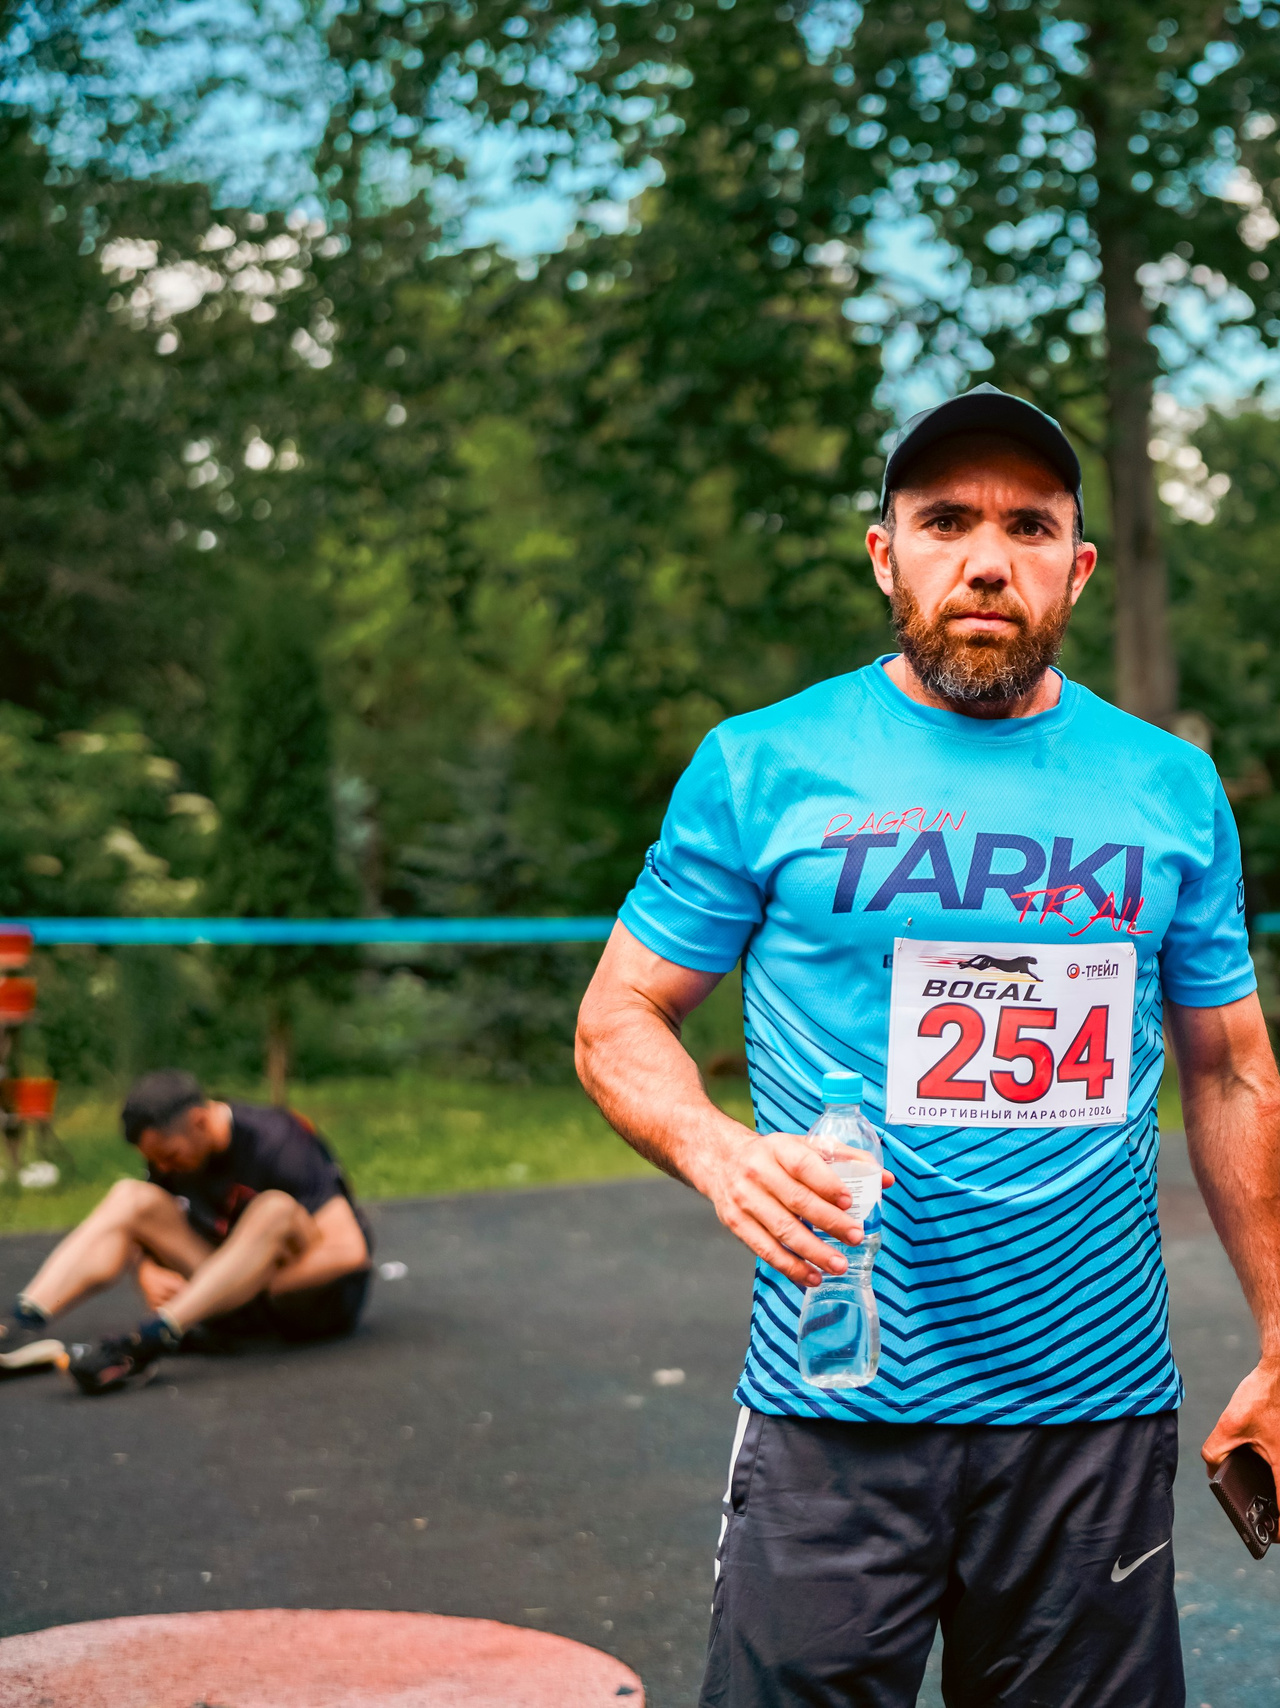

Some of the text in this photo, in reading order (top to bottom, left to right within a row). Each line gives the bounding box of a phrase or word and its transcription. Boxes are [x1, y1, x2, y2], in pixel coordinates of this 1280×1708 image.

[823, 807, 967, 842] DAGRUN
[820, 830, 1145, 923] TARKI
[1010, 884, 1154, 937] TRAIL
[922, 979, 1043, 1002] BOGAL
[916, 1002, 1115, 1104] 254
[908, 1106, 1112, 1120] СПОРТИВНЫЙ МАРАФОН 2026
